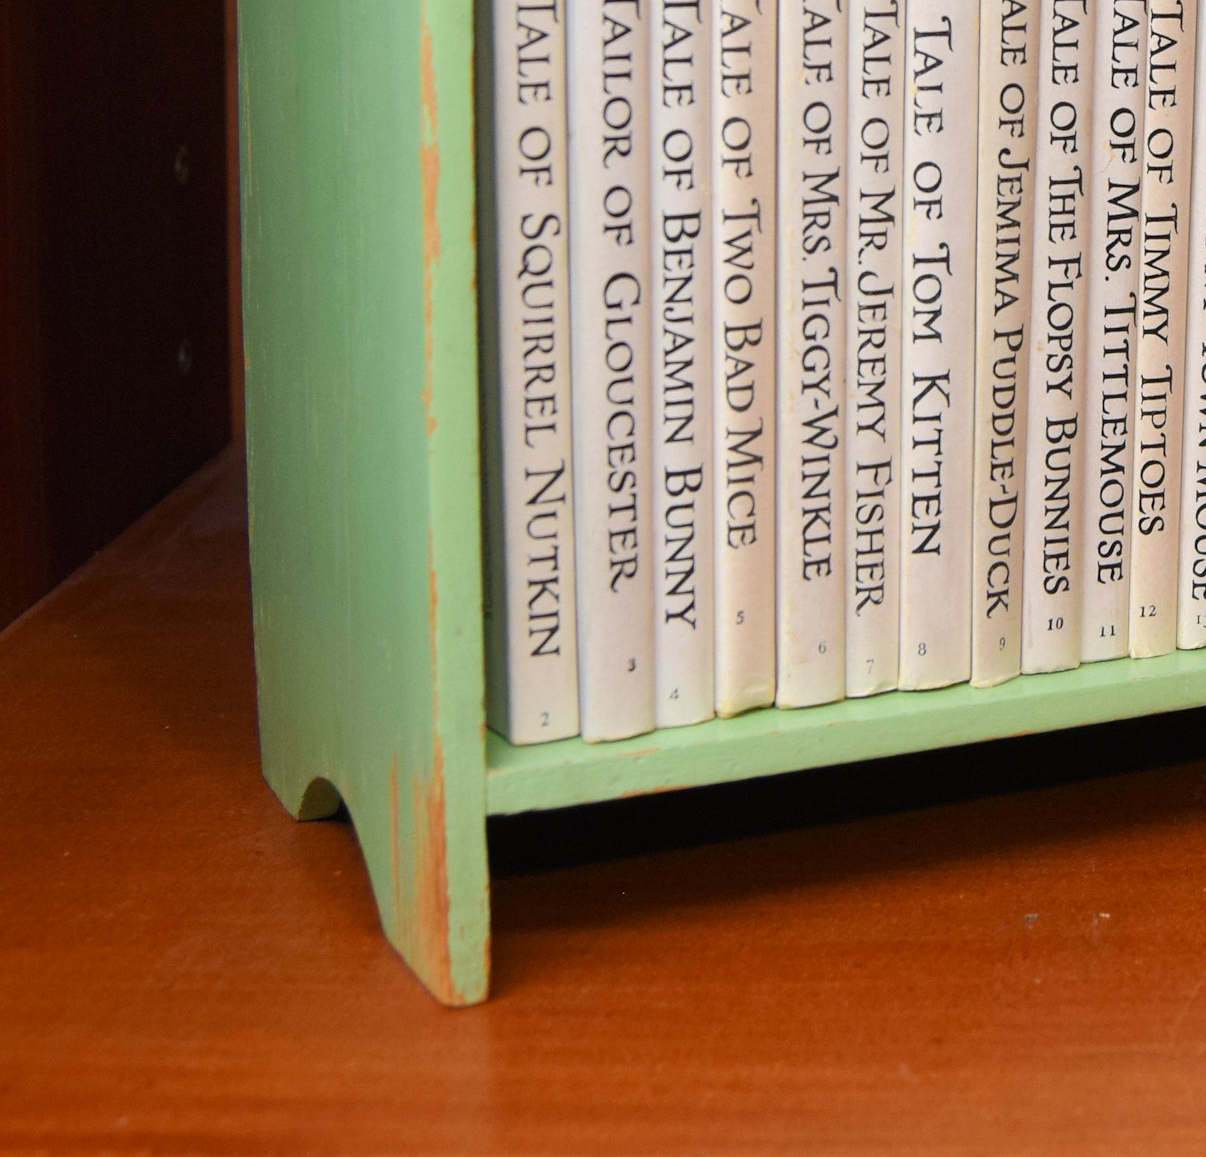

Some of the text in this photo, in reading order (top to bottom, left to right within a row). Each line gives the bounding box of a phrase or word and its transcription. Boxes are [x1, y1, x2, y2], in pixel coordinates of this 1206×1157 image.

[862, 0, 899, 99] TALE
[914, 16, 953, 136] TALE
[1149, 0, 1184, 110] TALE
[519, 127, 552, 186] OF
[663, 129, 694, 190] OF
[722, 117, 753, 178] OF
[803, 101, 832, 154] OF
[861, 118, 889, 172] OF
[999, 83, 1024, 138] OF
[1050, 102, 1078, 154] OF
[1110, 108, 1137, 163] OF
[1147, 129, 1173, 184] OF
[603, 185, 633, 245] OF
[803, 167, 840, 261] MRS.
[858, 186, 895, 264] MR.
[913, 162, 943, 219] OF
[994, 148, 1030, 317] JEMIMA
[1048, 165, 1084, 244] THE
[1105, 177, 1140, 281] MRS.
[723, 198, 762, 304] TWO
[913, 242, 952, 343] TOM
[1143, 203, 1178, 345] TIMMY
[518, 214, 560, 447] SQUIRREL
[663, 211, 701, 443] BENJAMIN
[724, 318, 763, 412] BAD
[857, 271, 894, 443] JEREMY
[1046, 252, 1082, 400] FLOPSY
[603, 272, 640, 593] GLOUCESTER
[801, 267, 841, 581] TIGGY-WINKLE
[911, 369, 950, 555] KITTEN
[987, 324, 1024, 619] PUDDLE-DUCK
[1097, 292, 1137, 584] TITTLEMOUSE
[1138, 364, 1172, 535] TIPTOES
[726, 418, 763, 549] MICE
[1043, 413, 1078, 595] BUNNIES
[525, 460, 566, 657] NUTKIN
[664, 462, 703, 629] BUNNY
[854, 455, 893, 616] FISHER
[736, 611, 745, 625] 5
[917, 643, 927, 656] 8
[1047, 617, 1064, 631] 10
[1099, 625, 1116, 638] 11
[1139, 605, 1157, 618] 12
[627, 658, 636, 672] 3
